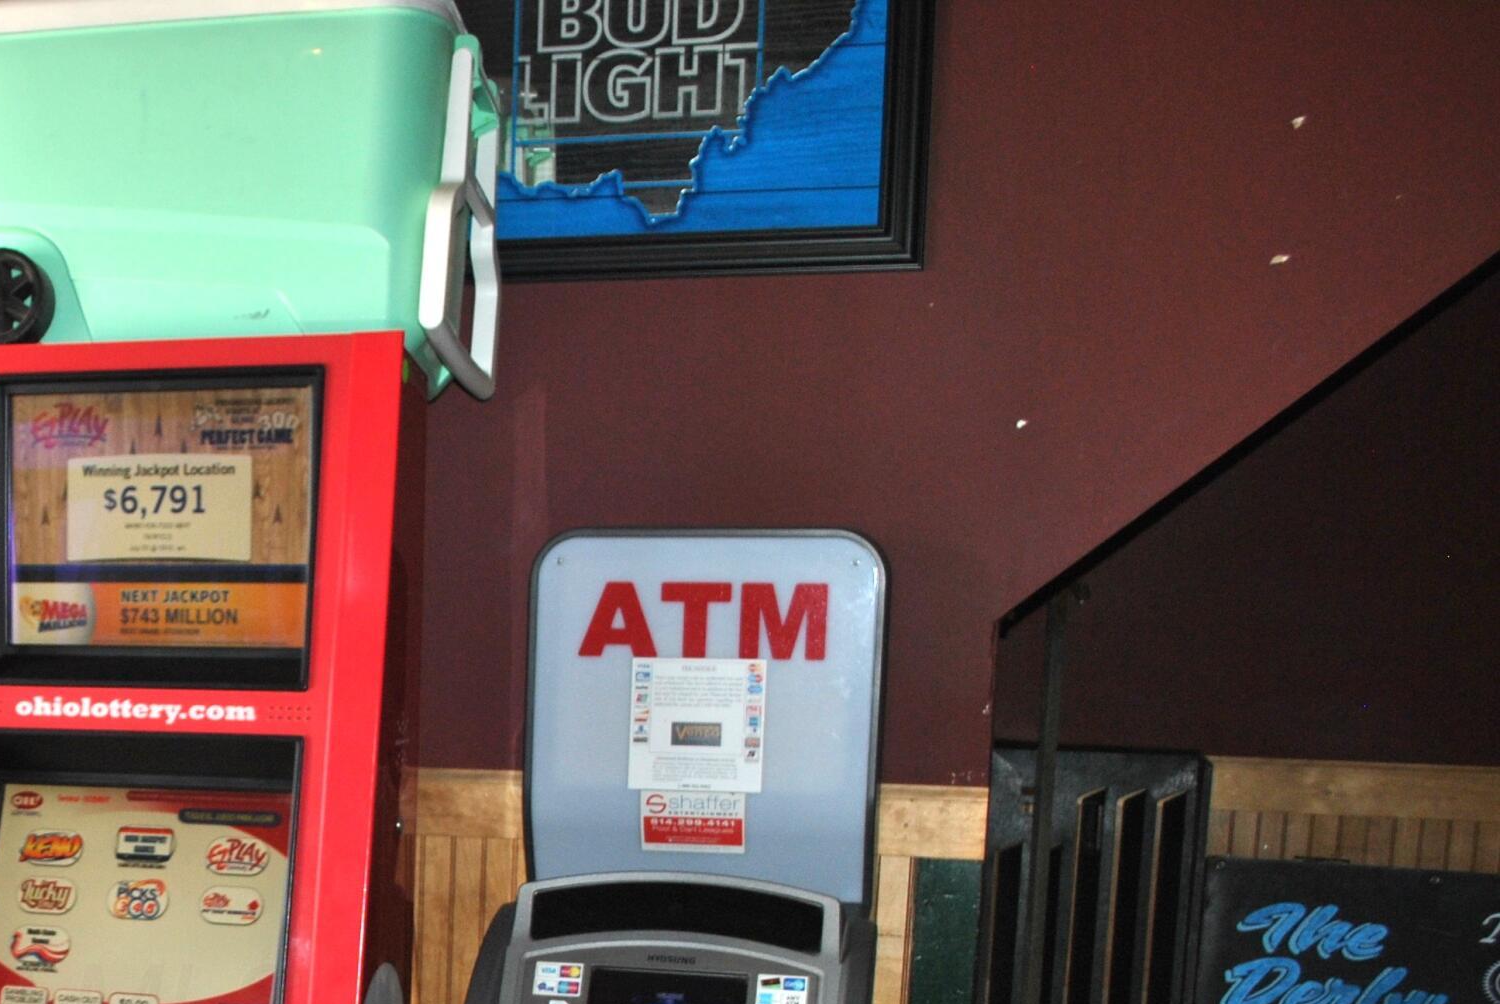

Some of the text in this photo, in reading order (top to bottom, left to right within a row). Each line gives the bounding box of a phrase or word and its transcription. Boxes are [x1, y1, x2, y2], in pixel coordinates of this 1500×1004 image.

[537, 0, 745, 53] BUD
[82, 463, 236, 479] Winning Jackpot Location
[104, 484, 206, 519] $6,791
[121, 590, 230, 603] NEXT JACKPOT
[120, 608, 238, 625] $743 MILLION
[578, 581, 828, 661] ATM
[15, 696, 256, 724] ohiolottery.com
[668, 794, 740, 809] shaffer
[1236, 902, 1389, 961] The
